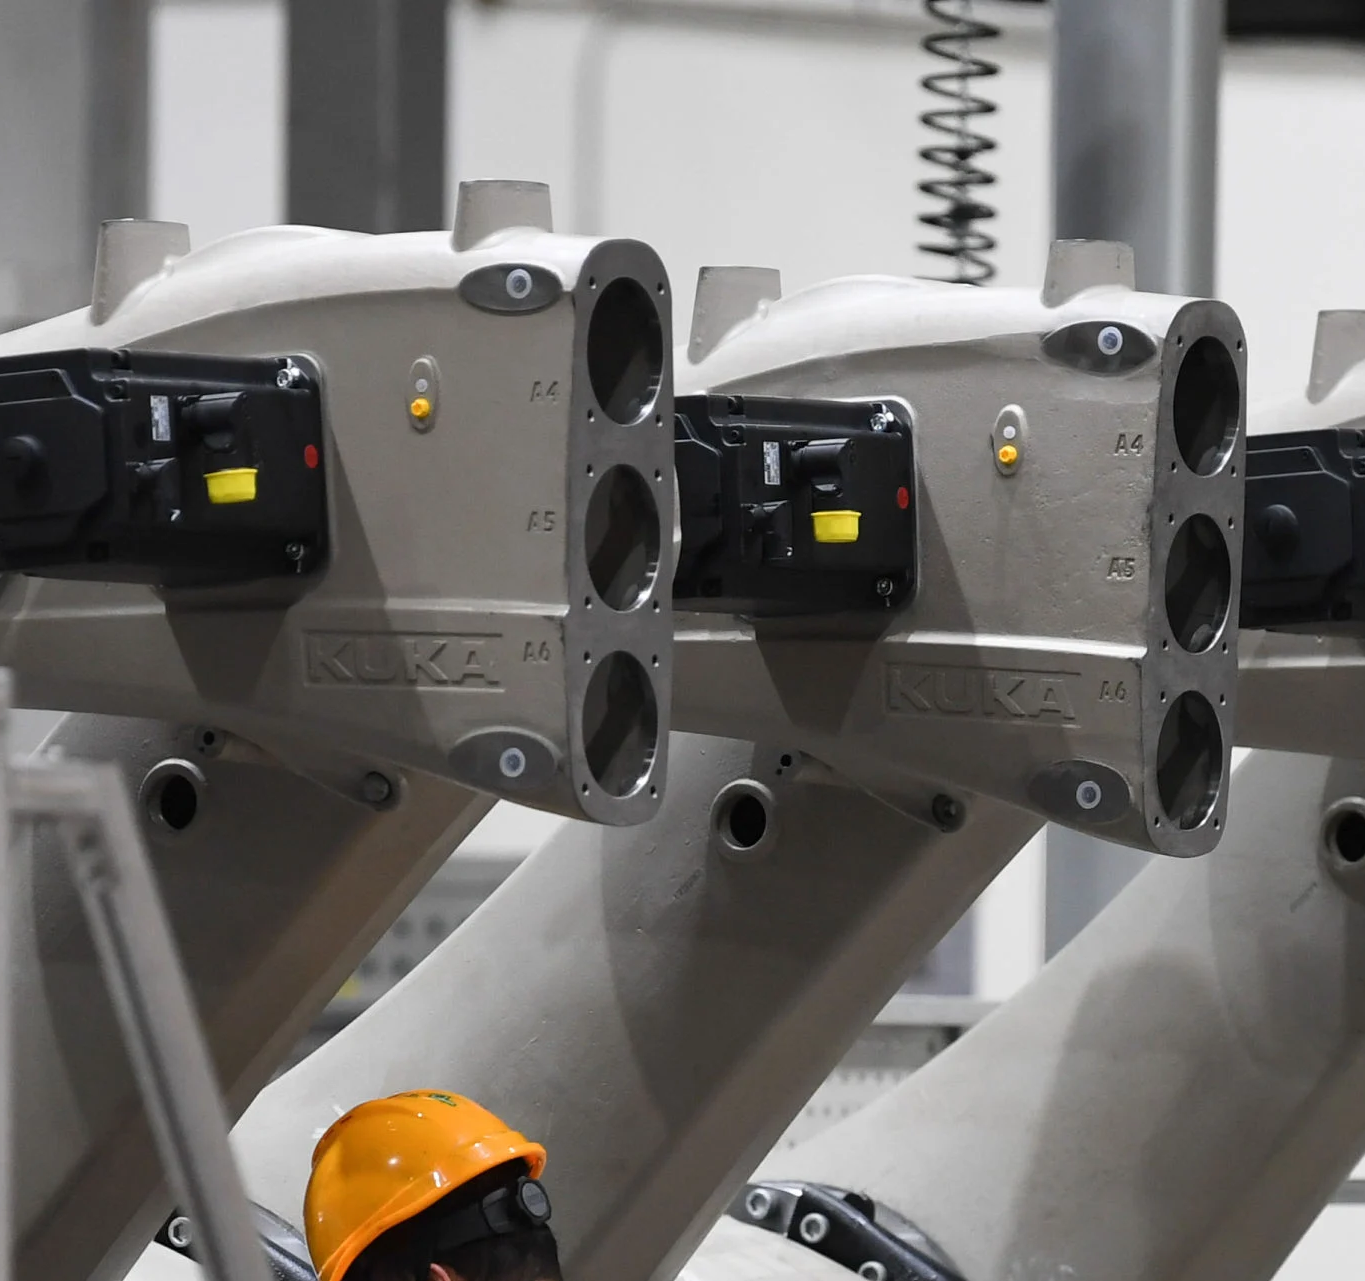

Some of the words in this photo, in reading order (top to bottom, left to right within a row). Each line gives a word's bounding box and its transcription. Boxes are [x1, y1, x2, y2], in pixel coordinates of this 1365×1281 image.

[530, 380, 560, 404] A4
[1114, 433, 1144, 457] A4
[526, 510, 555, 533] A5
[1106, 557, 1136, 580] A5
[307, 638, 501, 685] KUKA
[523, 641, 550, 664] A6
[887, 668, 1077, 720] KUKA
[1099, 680, 1128, 703] A6
